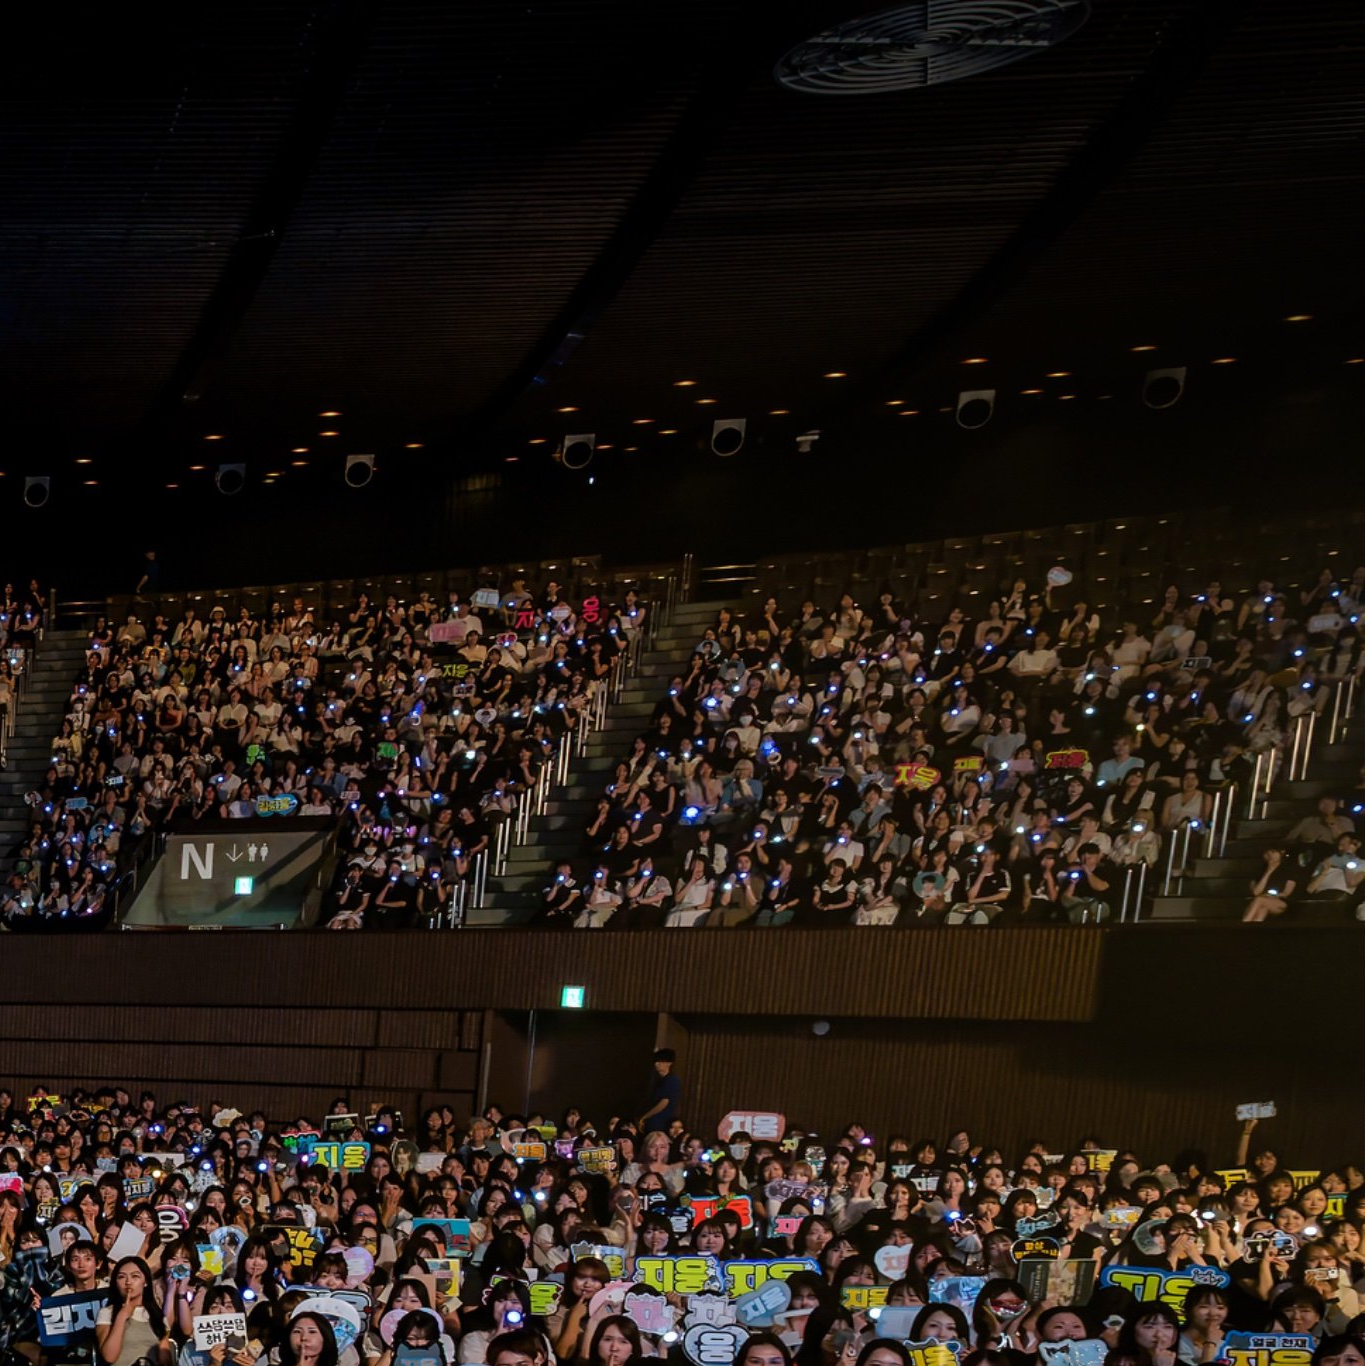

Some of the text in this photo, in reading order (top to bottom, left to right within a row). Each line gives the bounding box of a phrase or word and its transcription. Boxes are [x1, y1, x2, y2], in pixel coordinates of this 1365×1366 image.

[180, 843, 215, 880] N
[315, 1147, 367, 1170] 지웅
[638, 1258, 706, 1293] 지웅
[52, 1301, 111, 1335] 김지
[1282, 1336, 1308, 1348] 천재
